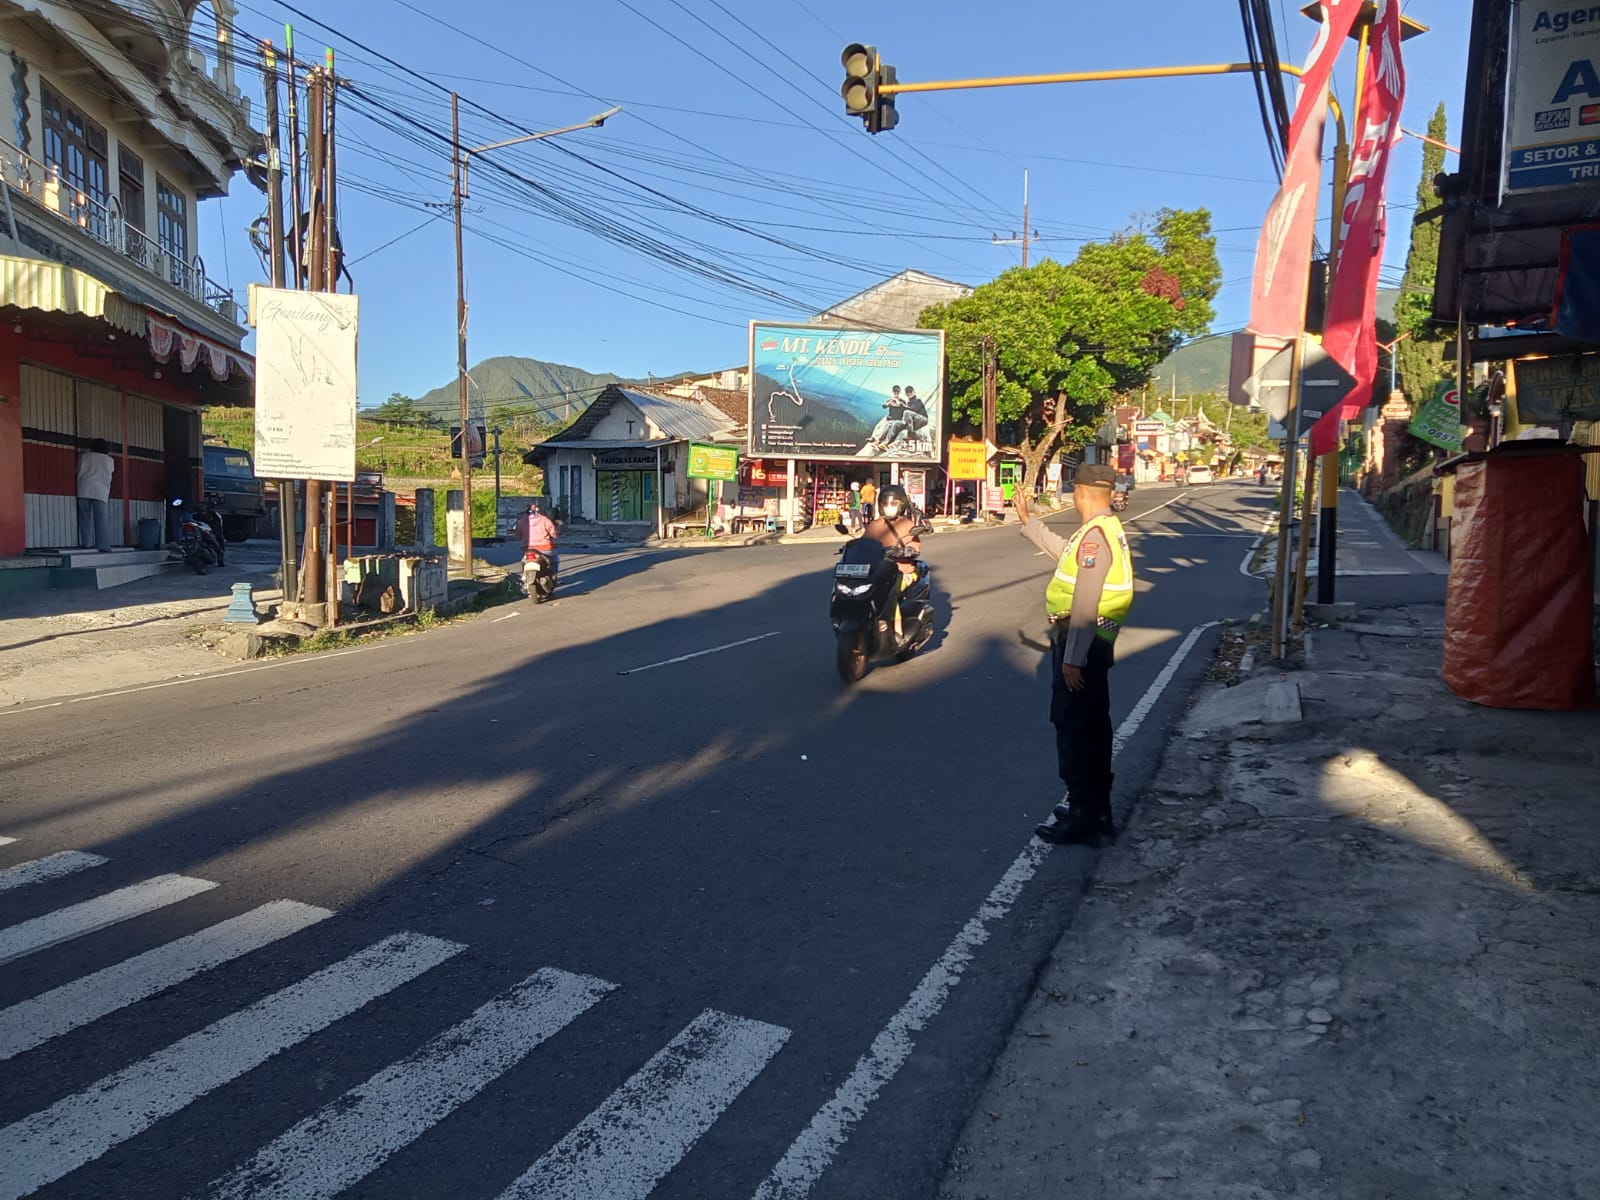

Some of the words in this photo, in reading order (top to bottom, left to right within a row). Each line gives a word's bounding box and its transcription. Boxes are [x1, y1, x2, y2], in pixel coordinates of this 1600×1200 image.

[1532, 7, 1600, 33] Agen
[1535, 119, 1569, 130] BERSAMA
[1537, 109, 1569, 123] ATM
[1523, 145, 1579, 163] SETOR
[1585, 143, 1597, 156] &
[1569, 165, 1600, 179] TRI
[781, 336, 810, 354] MT.
[814, 338, 872, 356] KENDIL
